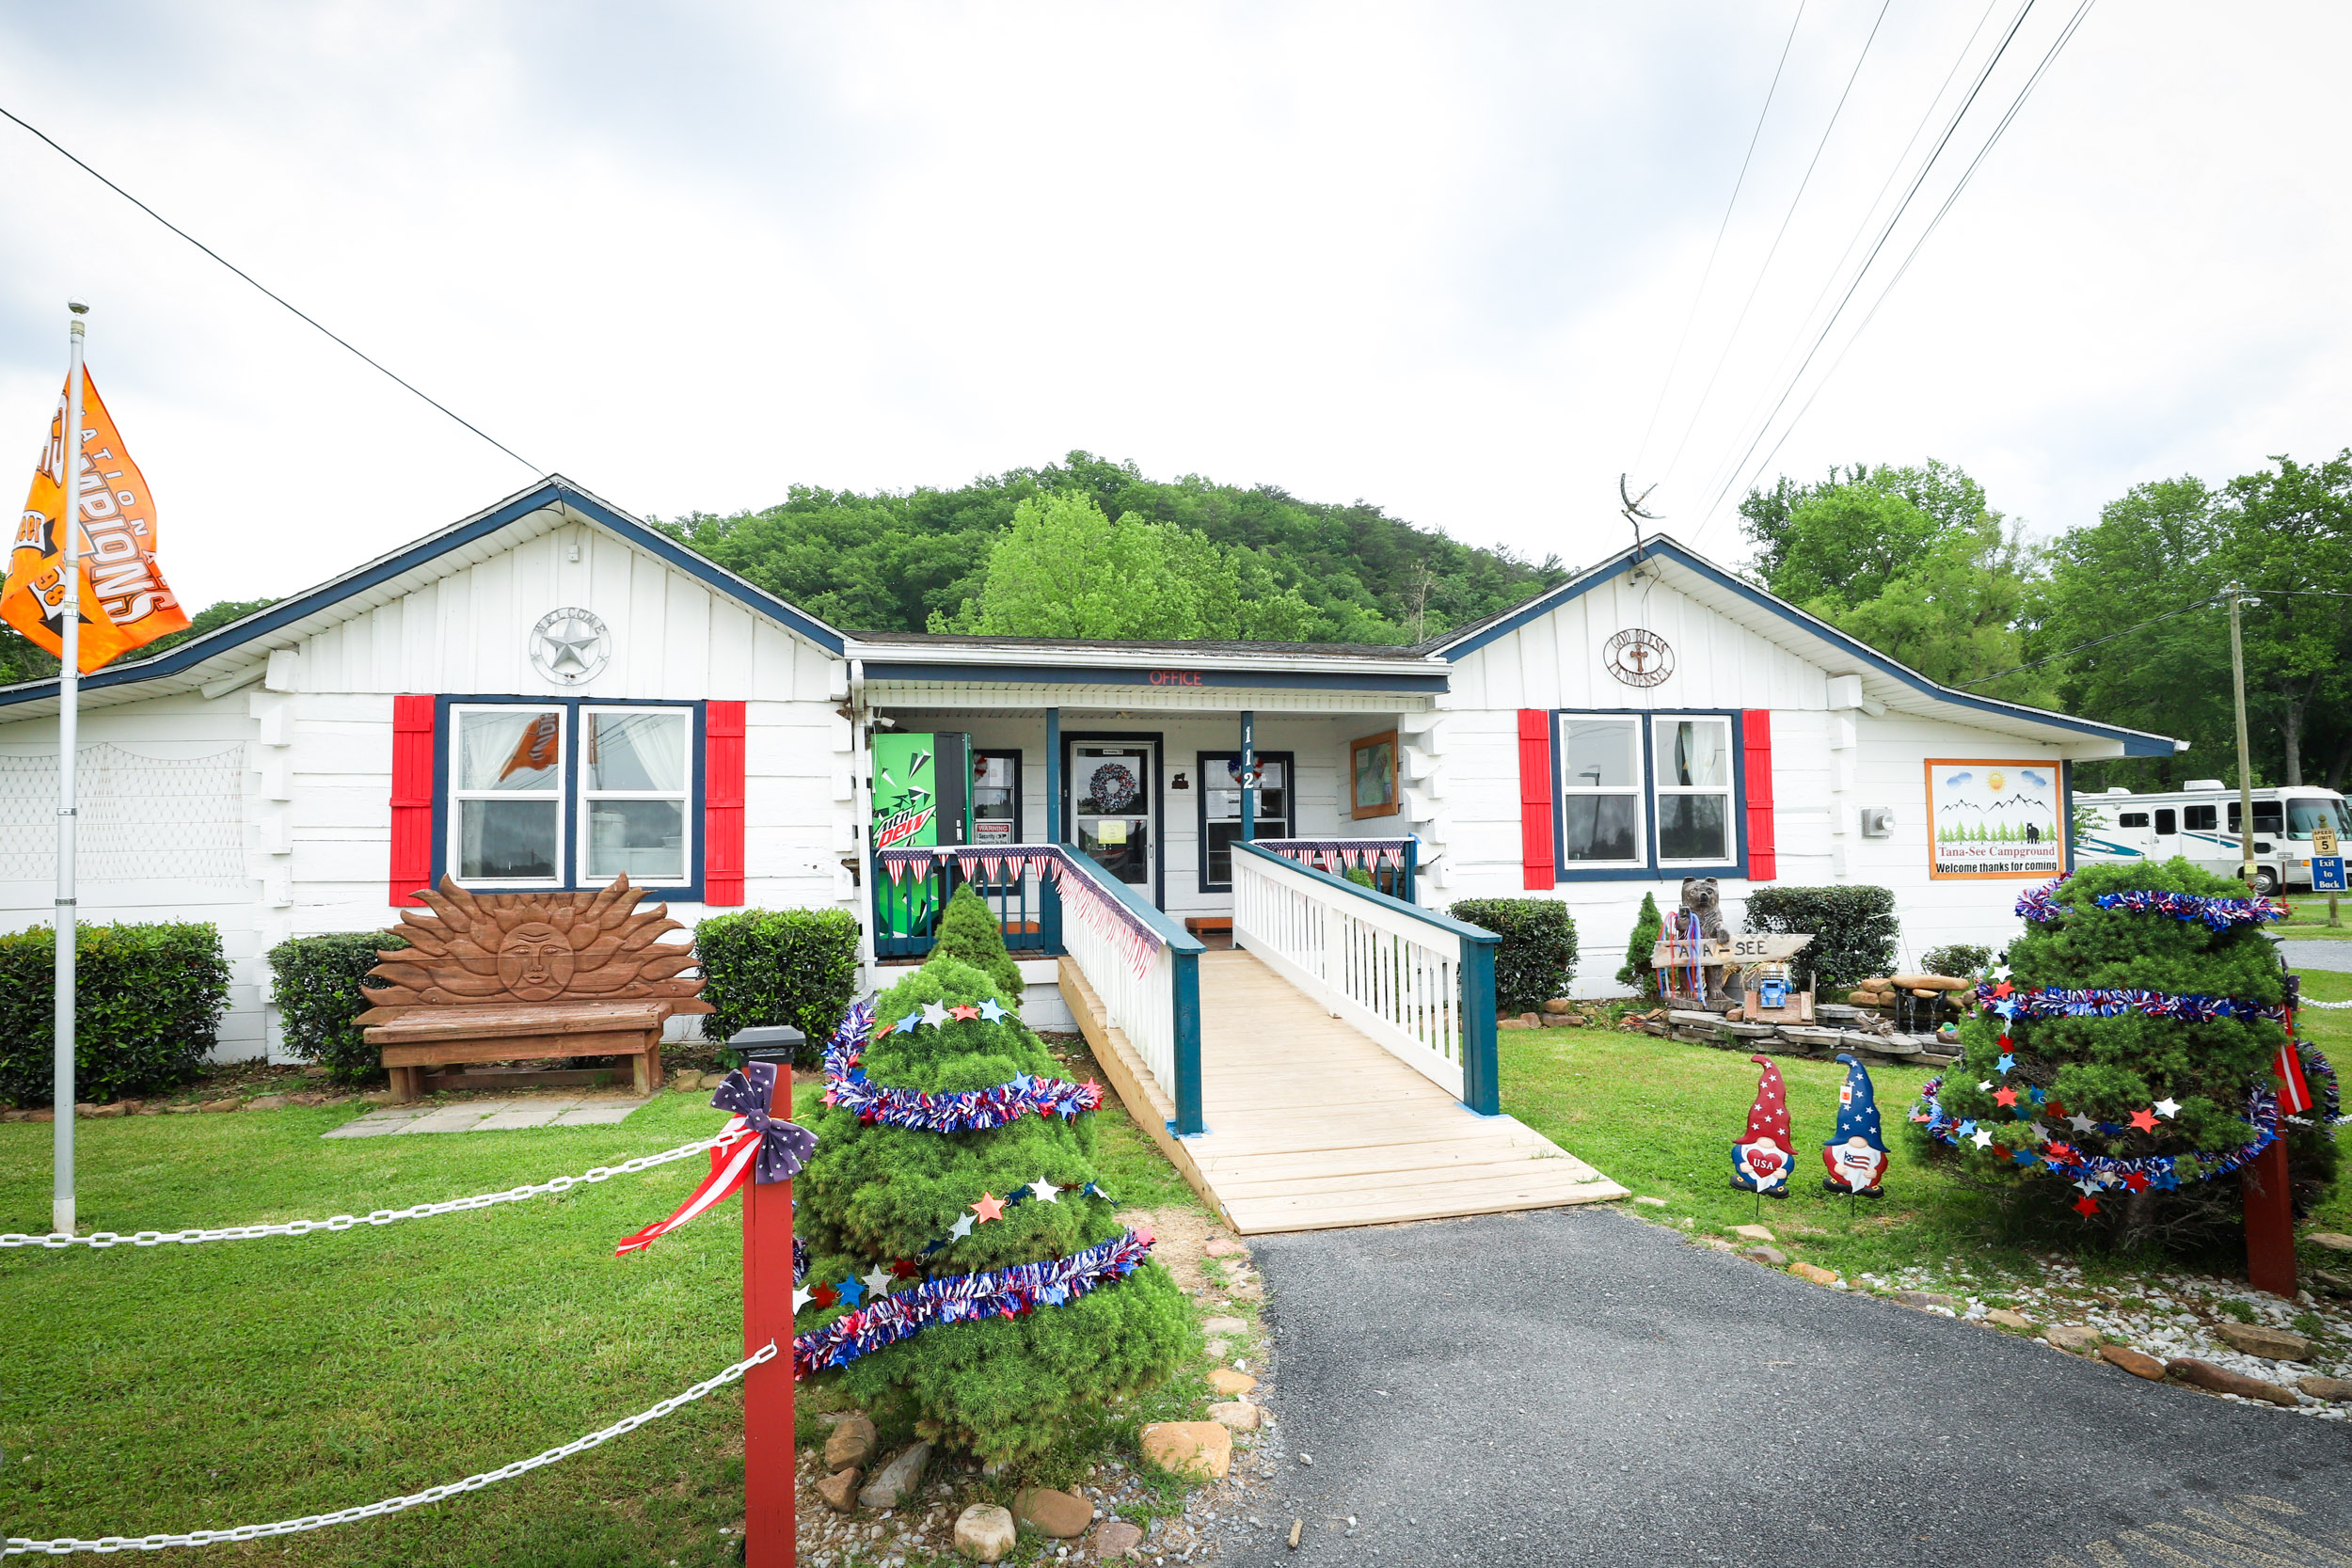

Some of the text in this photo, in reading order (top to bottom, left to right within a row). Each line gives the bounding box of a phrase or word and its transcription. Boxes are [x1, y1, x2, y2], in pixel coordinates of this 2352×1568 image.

[534, 607, 607, 636] WELCOME
[1611, 630, 1631, 650] GOD
[1150, 670, 1203, 686] OFFICE
[2322, 841, 2329, 850] 5
[1939, 847, 2056, 858] Tana-See Campground
[1936, 862, 2058, 873] Welcome thanks for coming
[2319, 859, 2335, 867] Exit
[2319, 880, 2340, 889] Back
[1753, 1158, 1774, 1170] USA
